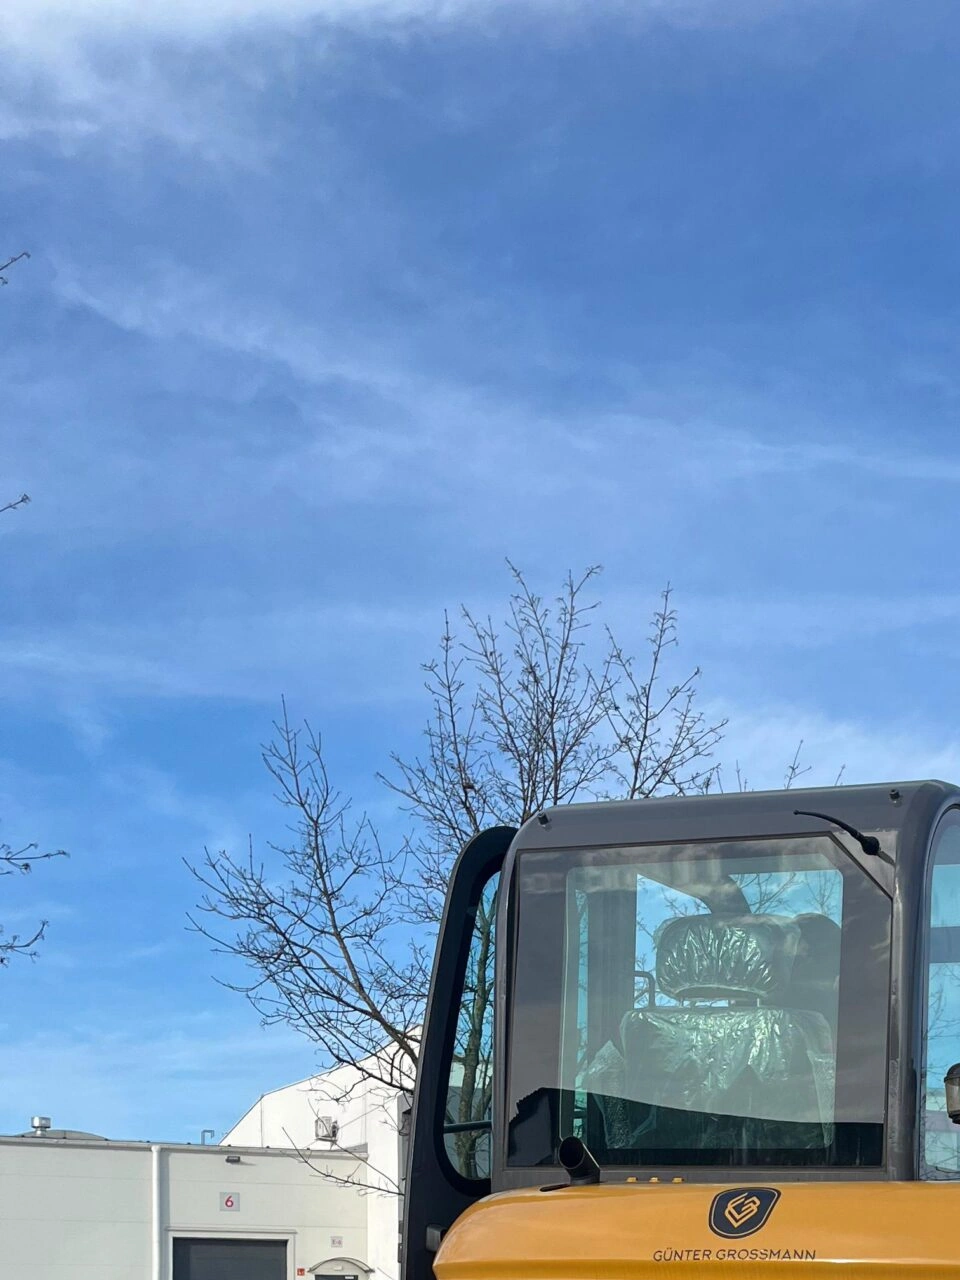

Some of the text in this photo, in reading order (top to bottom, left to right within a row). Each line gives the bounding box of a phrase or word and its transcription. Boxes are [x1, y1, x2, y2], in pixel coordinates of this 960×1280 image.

[225, 1195, 234, 1208] 6
[653, 1247, 816, 1262] GÜNTER GROSSMANN
